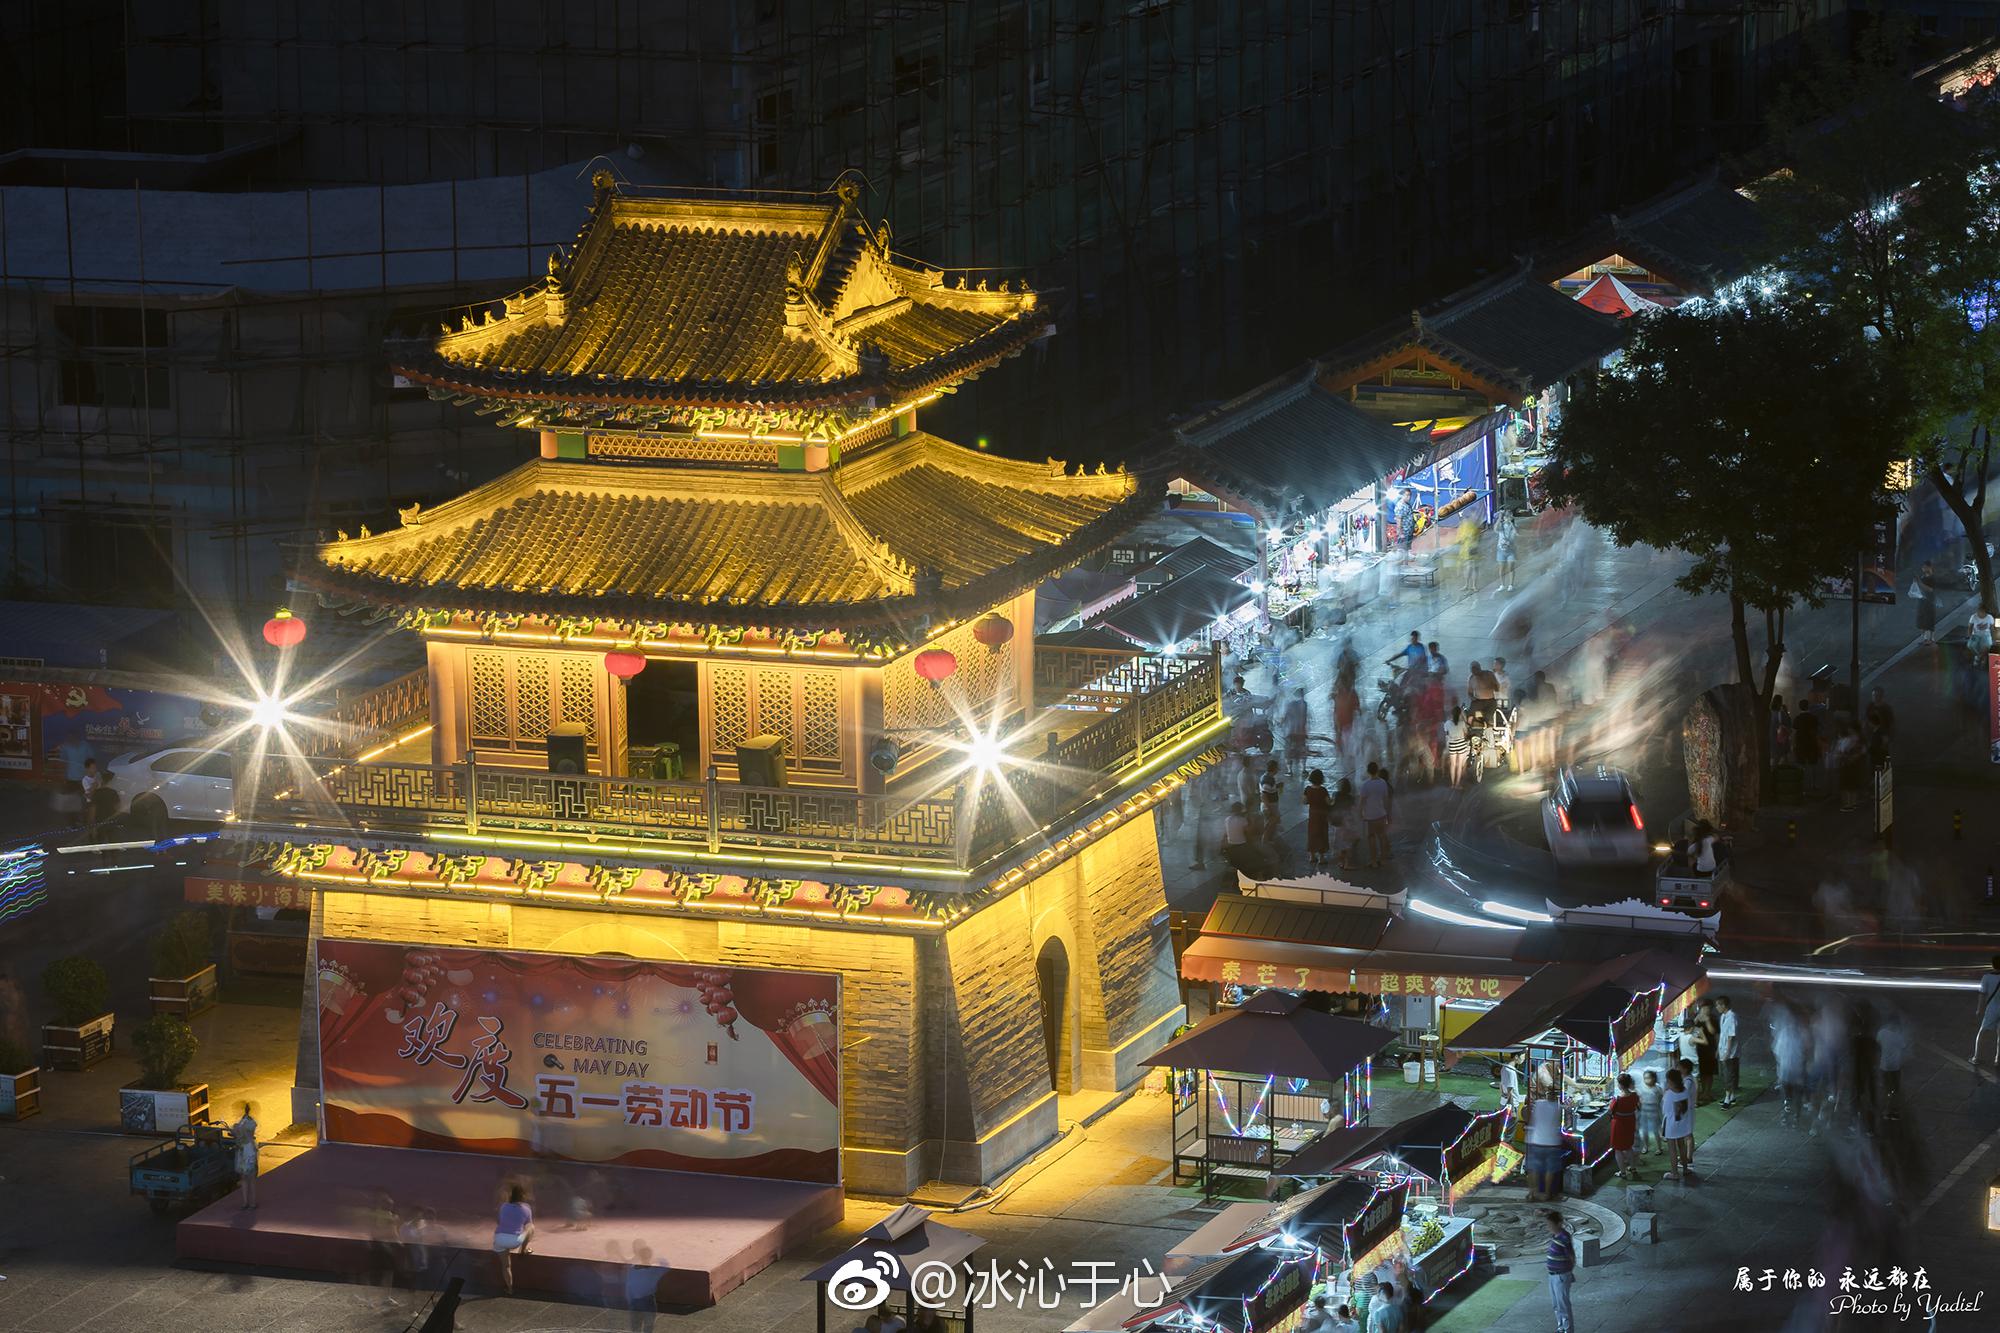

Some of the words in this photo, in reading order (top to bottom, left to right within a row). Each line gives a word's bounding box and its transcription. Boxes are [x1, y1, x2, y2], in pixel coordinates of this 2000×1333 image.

[1222, 961, 1311, 988] 泰芒了
[1380, 973, 1501, 998] 超爽冷饮吧
[397, 1001, 531, 1110] 欢度
[533, 1032, 649, 1057] CELEBRATING
[573, 1058, 611, 1077] MAY
[614, 1059, 650, 1079] DAY
[536, 1075, 755, 1135] 五一劳动节
